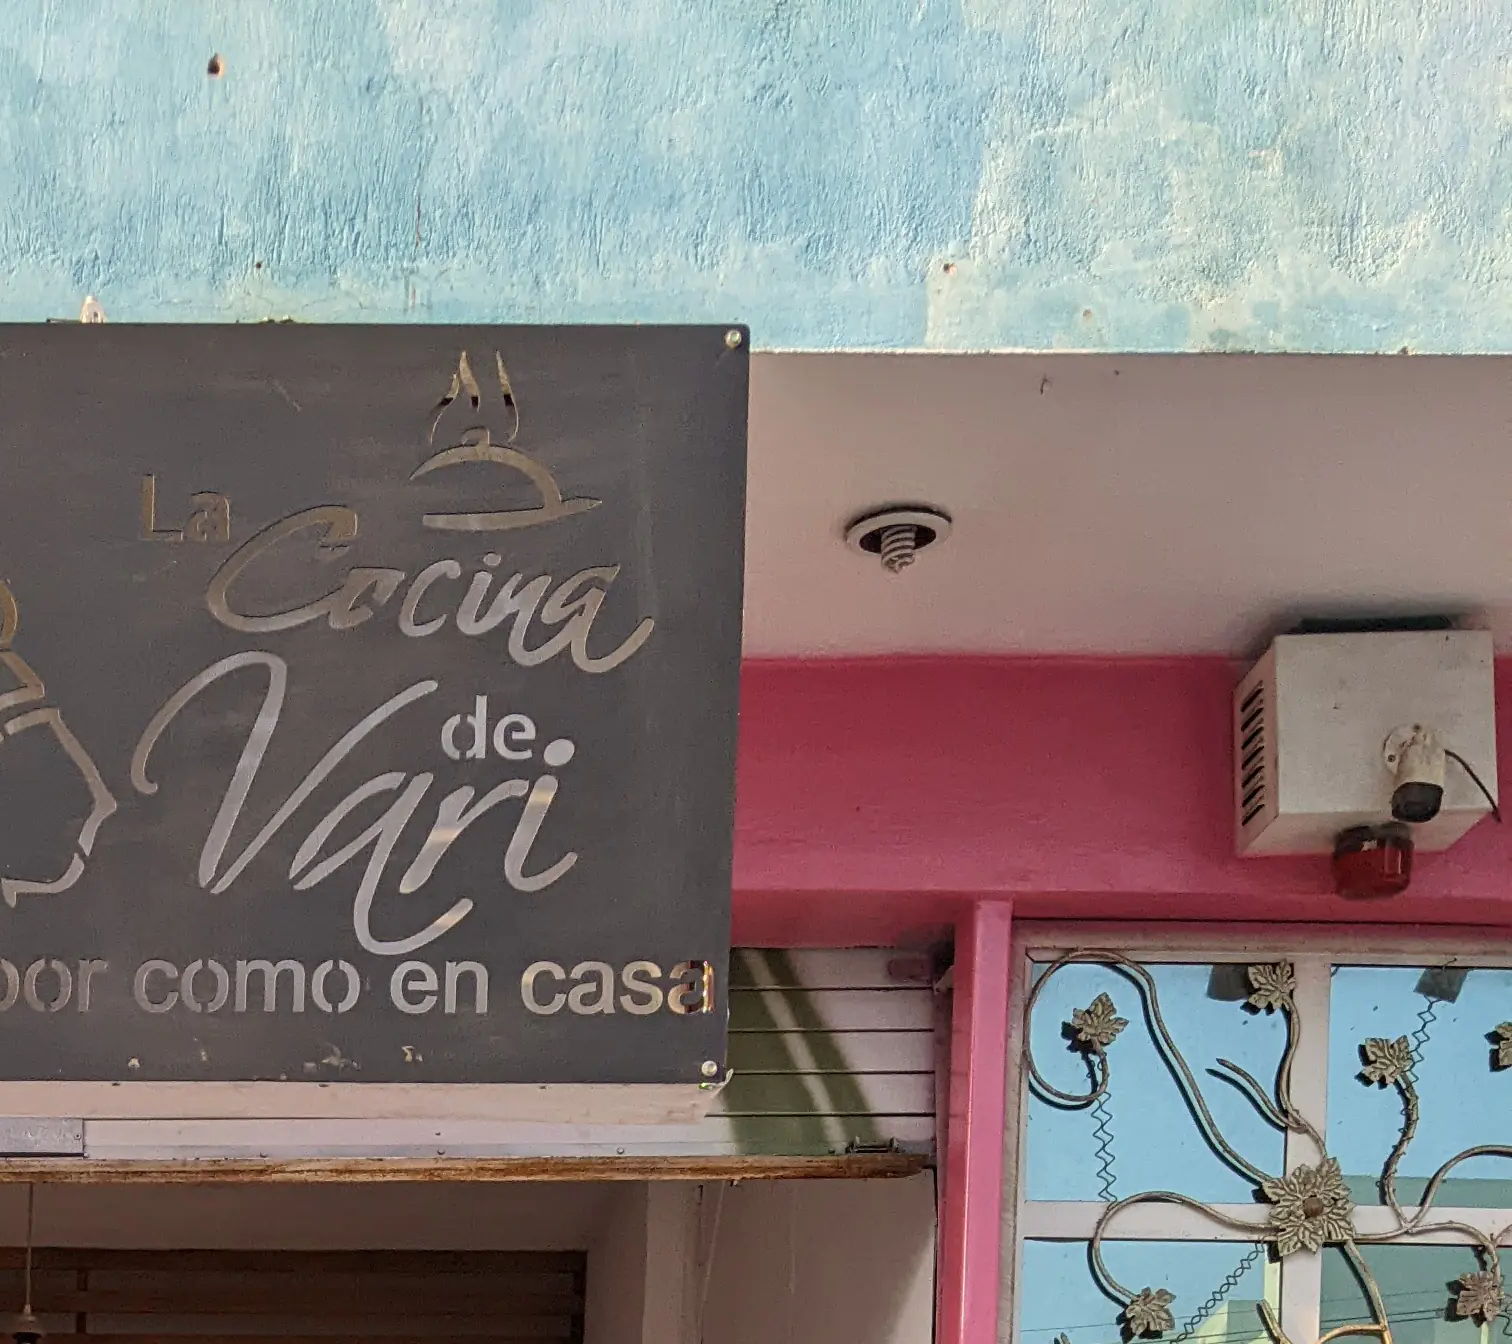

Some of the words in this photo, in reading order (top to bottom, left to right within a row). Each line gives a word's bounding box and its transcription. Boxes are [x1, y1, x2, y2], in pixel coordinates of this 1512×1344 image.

[140, 472, 231, 543] La
[207, 504, 655, 673] Cocina
[441, 695, 538, 761] de
[130, 649, 578, 956] Vari
[133, 958, 360, 1015] como
[390, 958, 489, 1015] en
[521, 958, 715, 1015] casa
